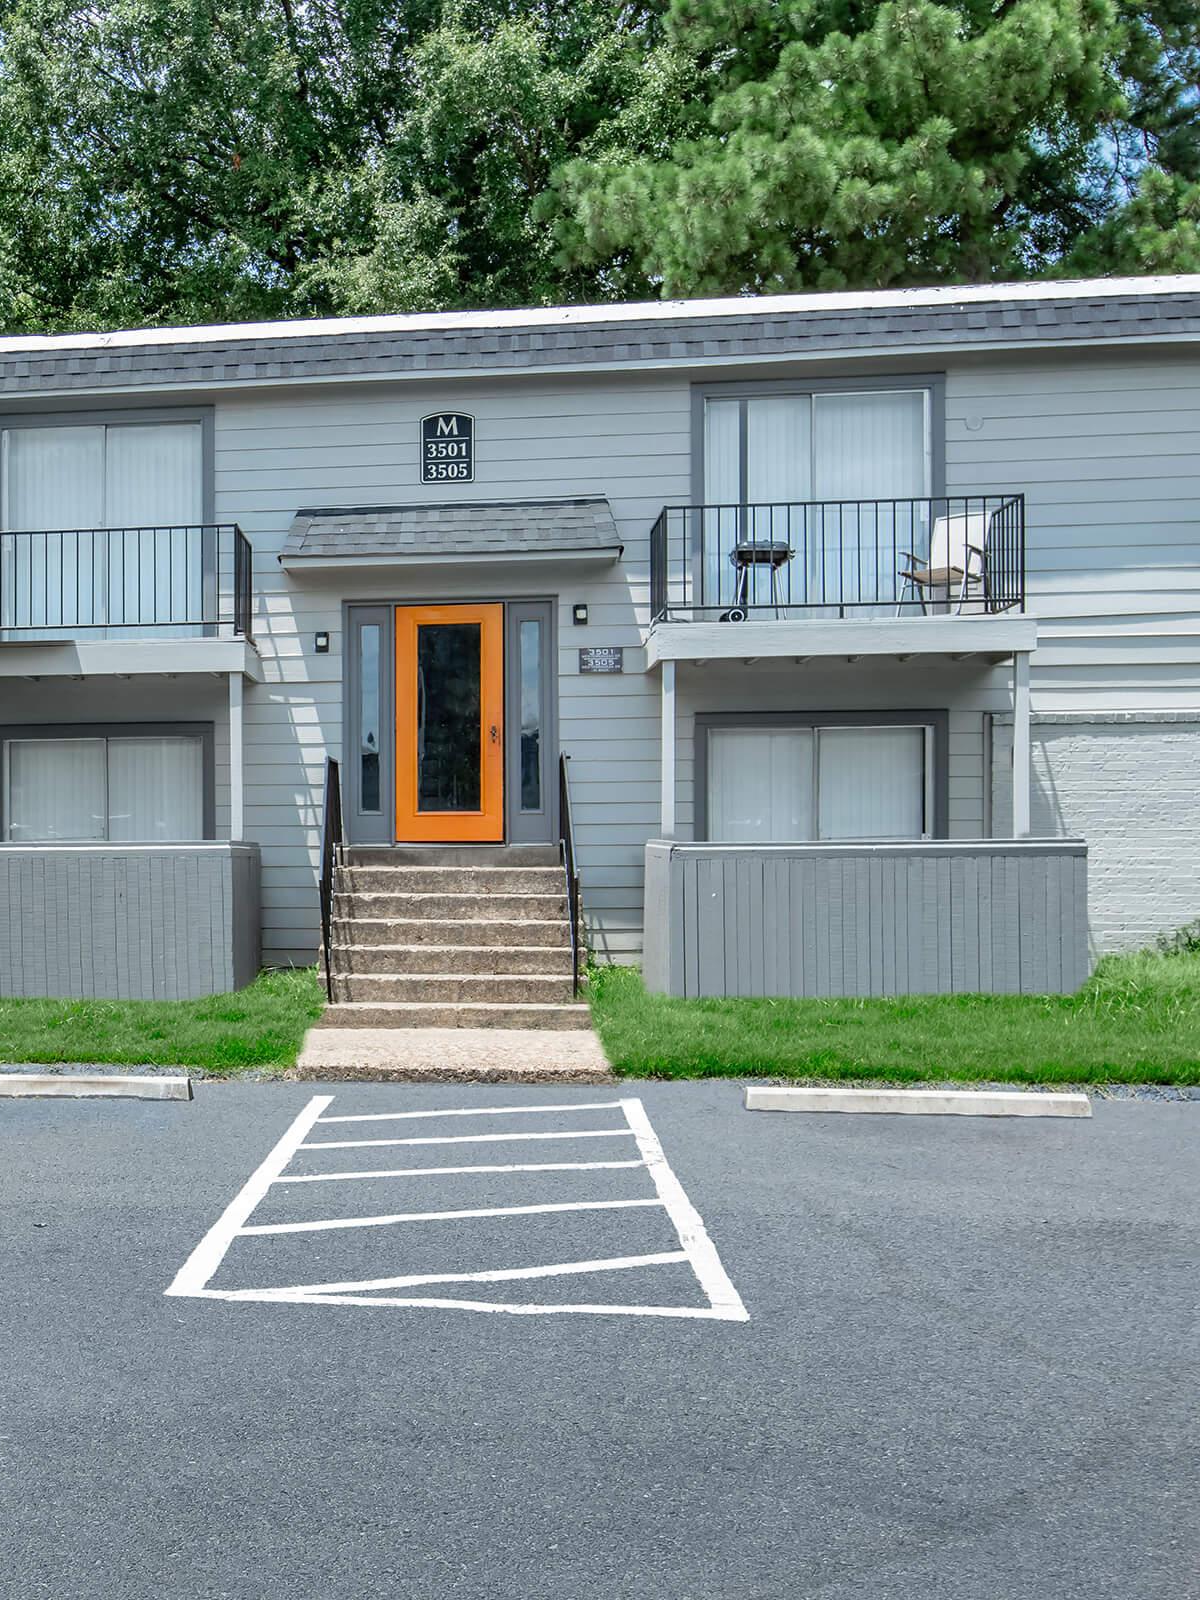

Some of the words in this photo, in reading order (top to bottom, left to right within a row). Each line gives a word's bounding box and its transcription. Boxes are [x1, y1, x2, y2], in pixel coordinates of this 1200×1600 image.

[436, 416, 459, 436] M
[427, 442, 467, 458] 3501
[427, 463, 468, 479] 3505
